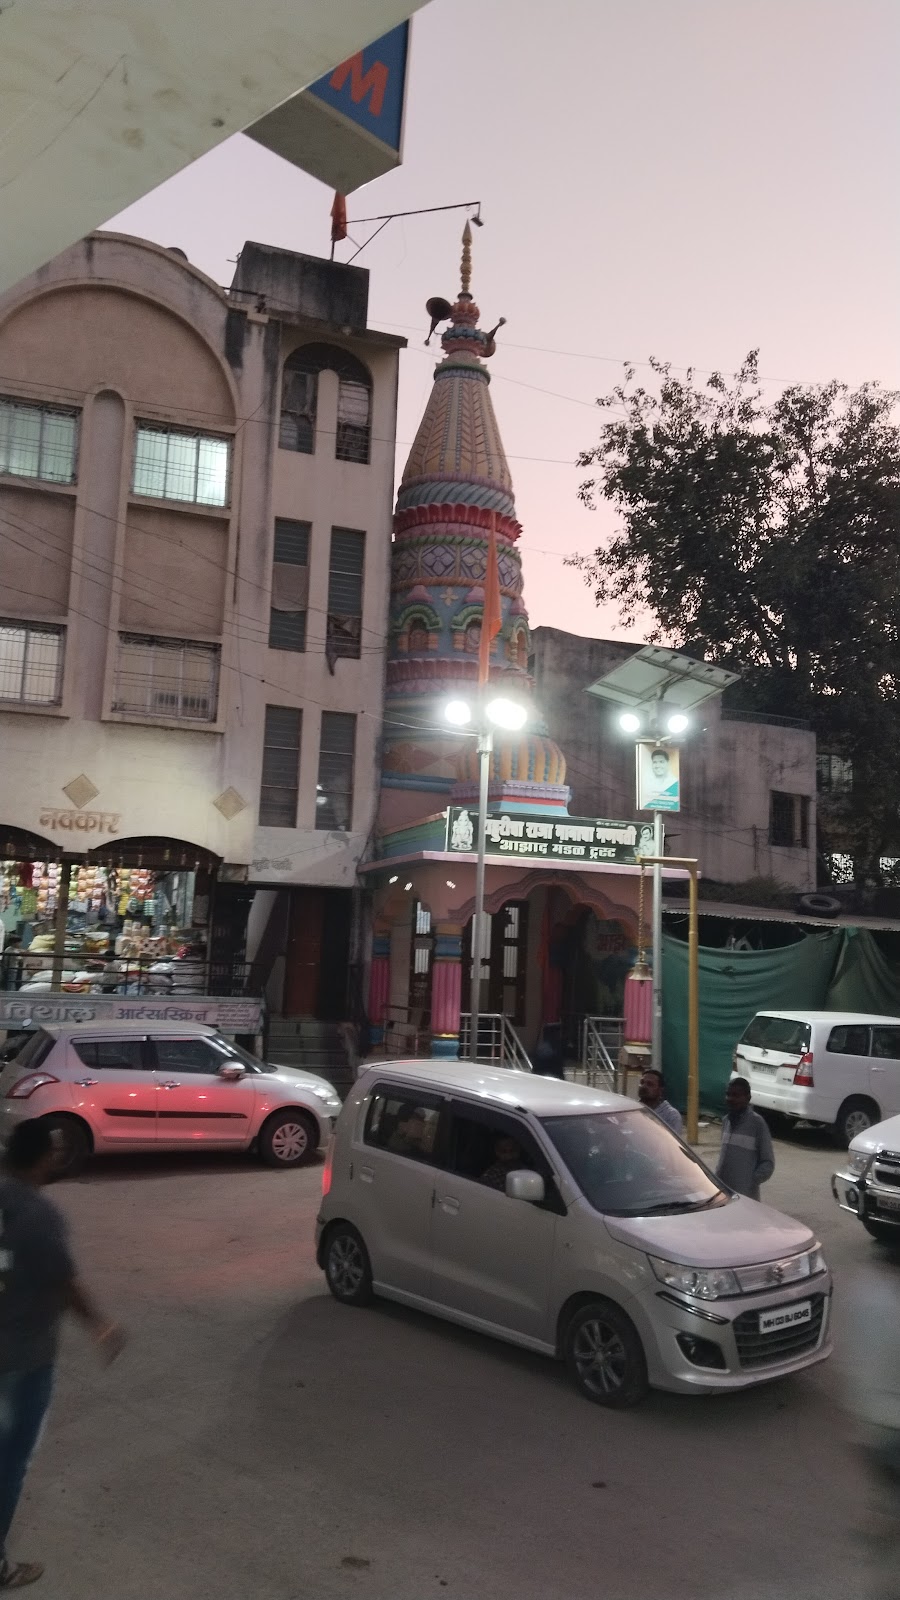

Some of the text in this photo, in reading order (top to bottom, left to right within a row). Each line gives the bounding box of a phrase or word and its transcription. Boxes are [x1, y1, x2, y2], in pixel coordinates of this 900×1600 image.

[39, 807, 122, 834] नवकार
[485, 815, 525, 843] ाहुरीचा
[596, 826, 637, 845] गणपती
[499, 839, 616, 859] आझाद मंडळ ट्रस्ट
[763, 1319, 774, 1328] MH
